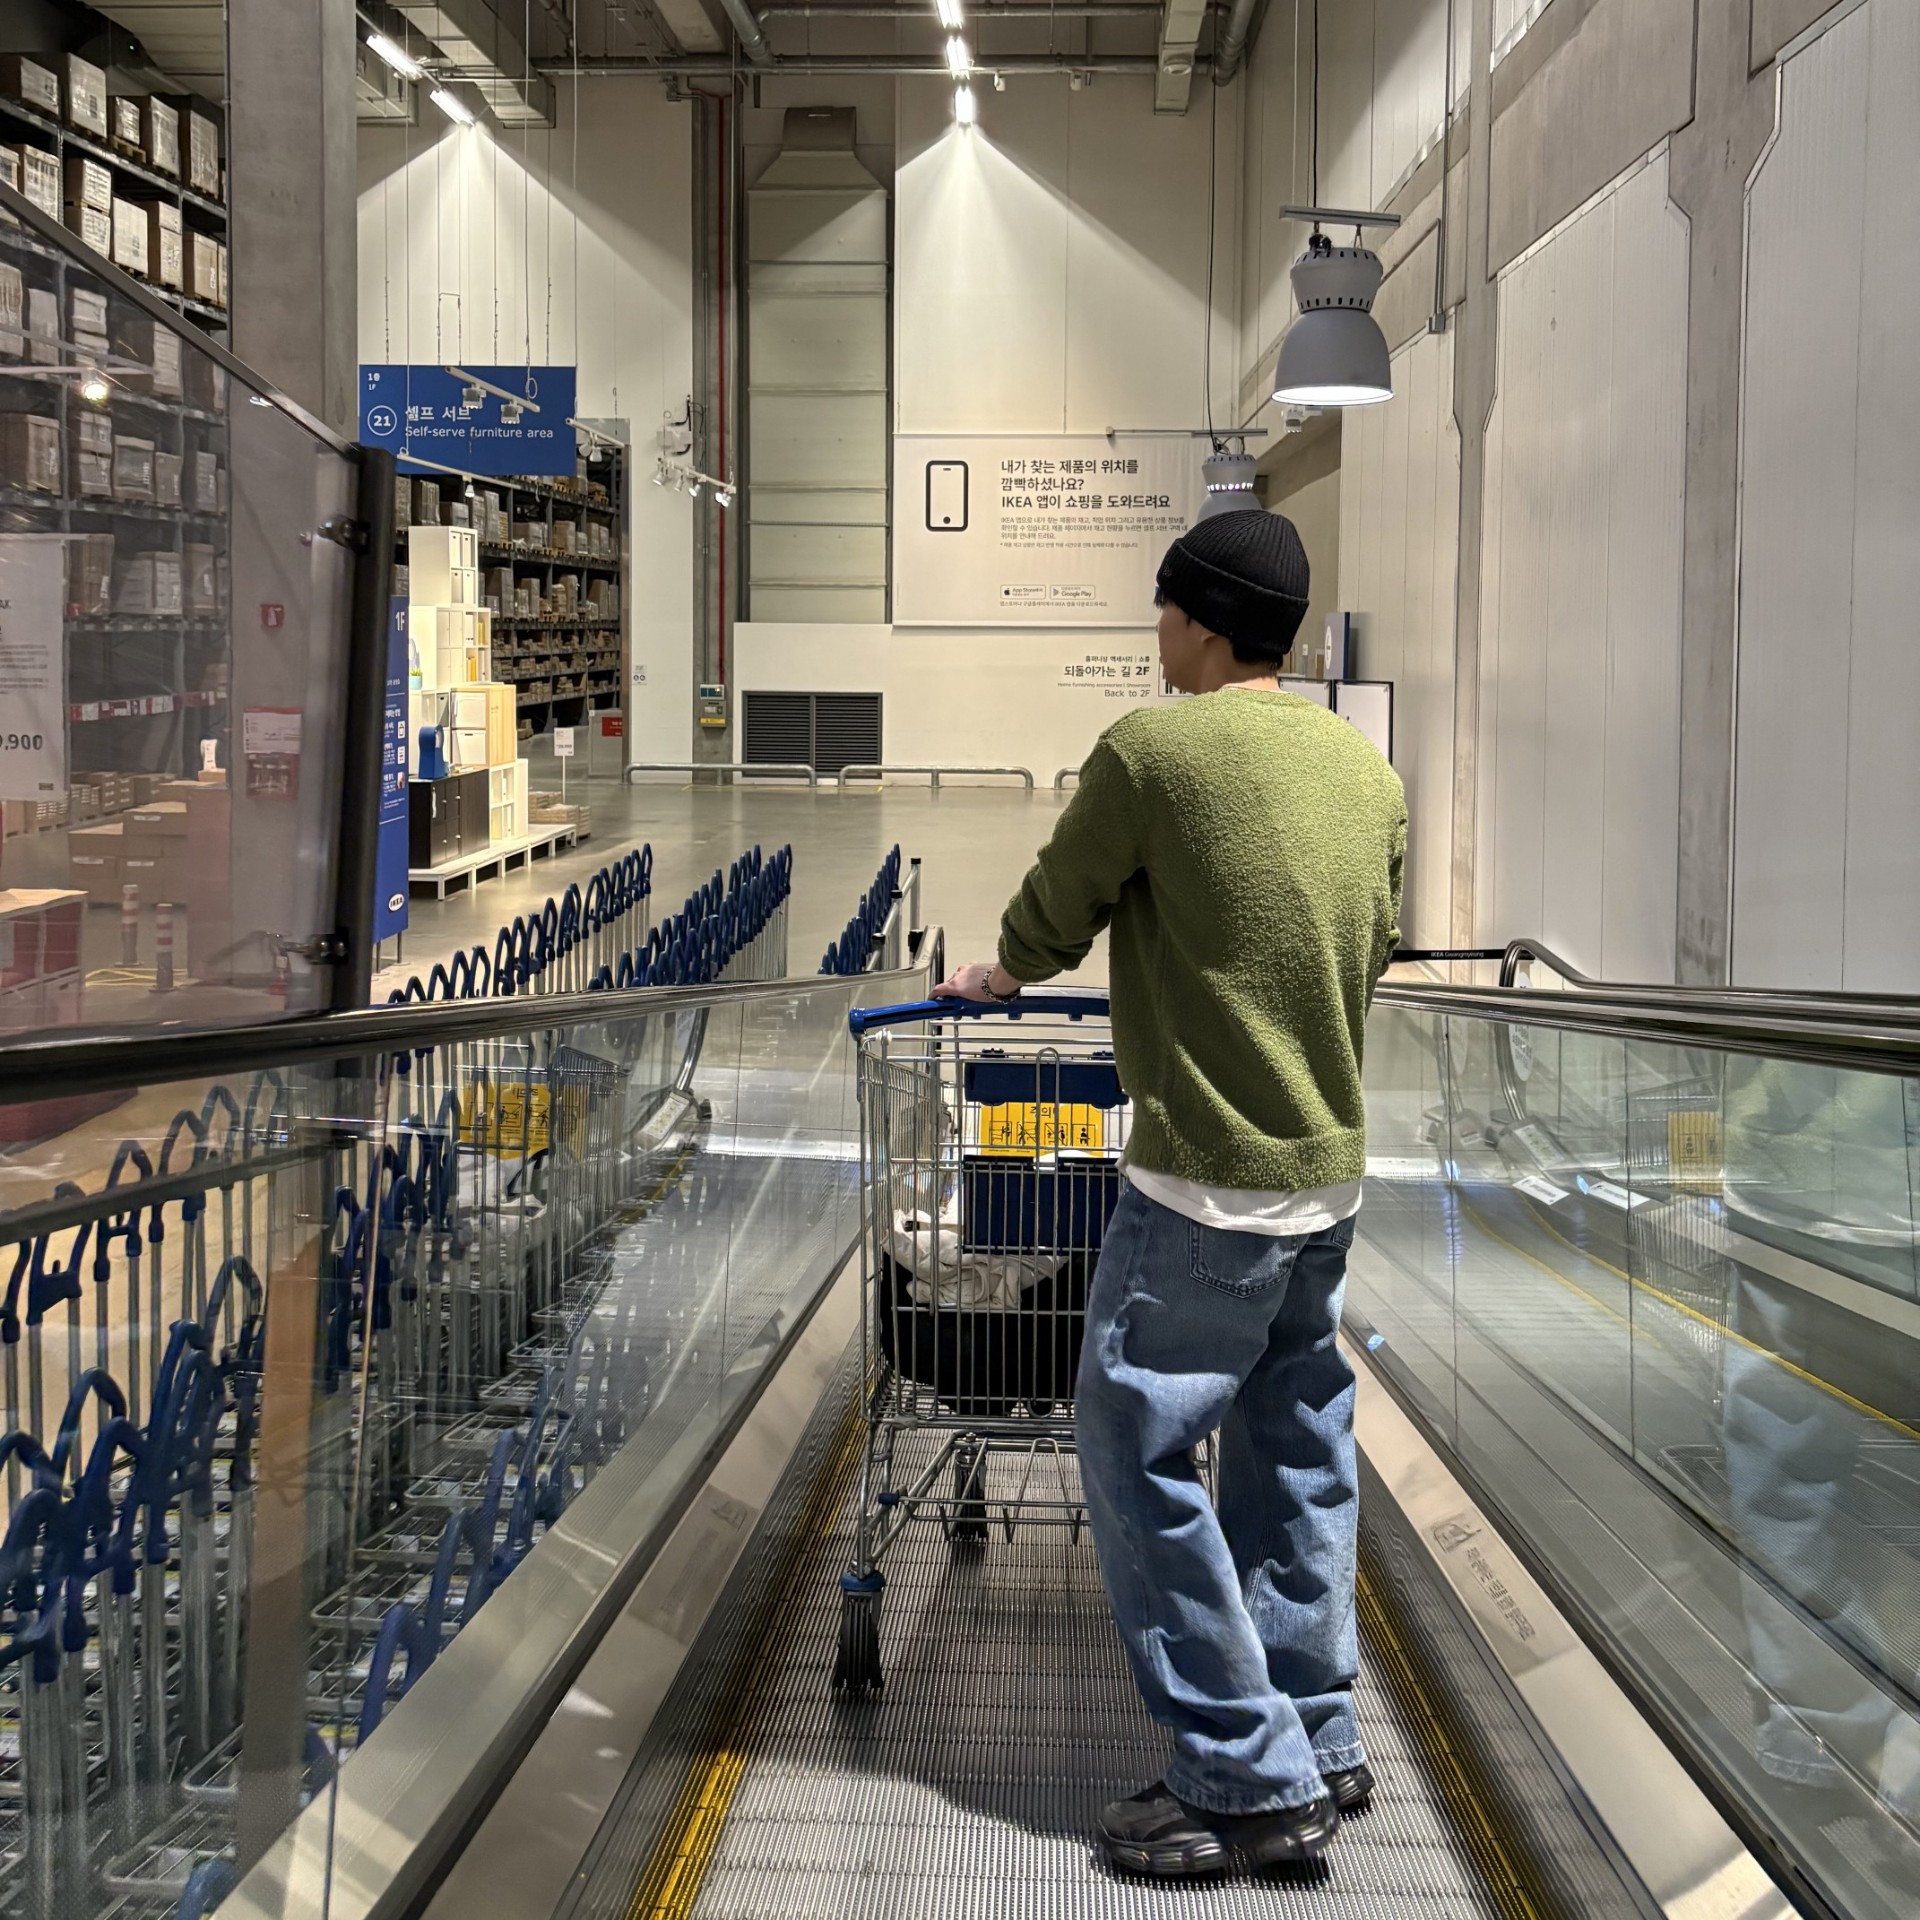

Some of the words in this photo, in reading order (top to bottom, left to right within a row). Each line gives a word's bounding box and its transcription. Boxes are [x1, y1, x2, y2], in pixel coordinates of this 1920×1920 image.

[405, 405, 435, 422] 셀프
[442, 405, 472, 422] 서브
[373, 415, 391, 427] 21
[405, 425, 466, 438] Self-serve
[469, 426, 523, 439] furniture
[527, 429, 554, 438] area
[1001, 459, 1027, 474] 내가
[1030, 459, 1056, 474] 찾는
[1059, 459, 1096, 474] 제품의
[1101, 459, 1139, 474] 위치를
[1000, 477, 1085, 492] 깜빡하셨나요?
[1001, 496, 1033, 508] IKEA
[1036, 494, 1061, 509] 앱이
[1065, 494, 1103, 509] 쇼핑을
[1106, 494, 1171, 509] 도와드려요
[1061, 590, 1081, 598] Google
[1081, 590, 1092, 598] Play
[395, 610, 406, 632] 1F
[1063, 664, 1117, 678] 되돌아가는
[1121, 665, 1131, 678] 길
[1136, 666, 1150, 676] 2F
[1104, 689, 1125, 698] Back
[1128, 689, 1139, 698] to
[1140, 689, 1151, 698] 2F
